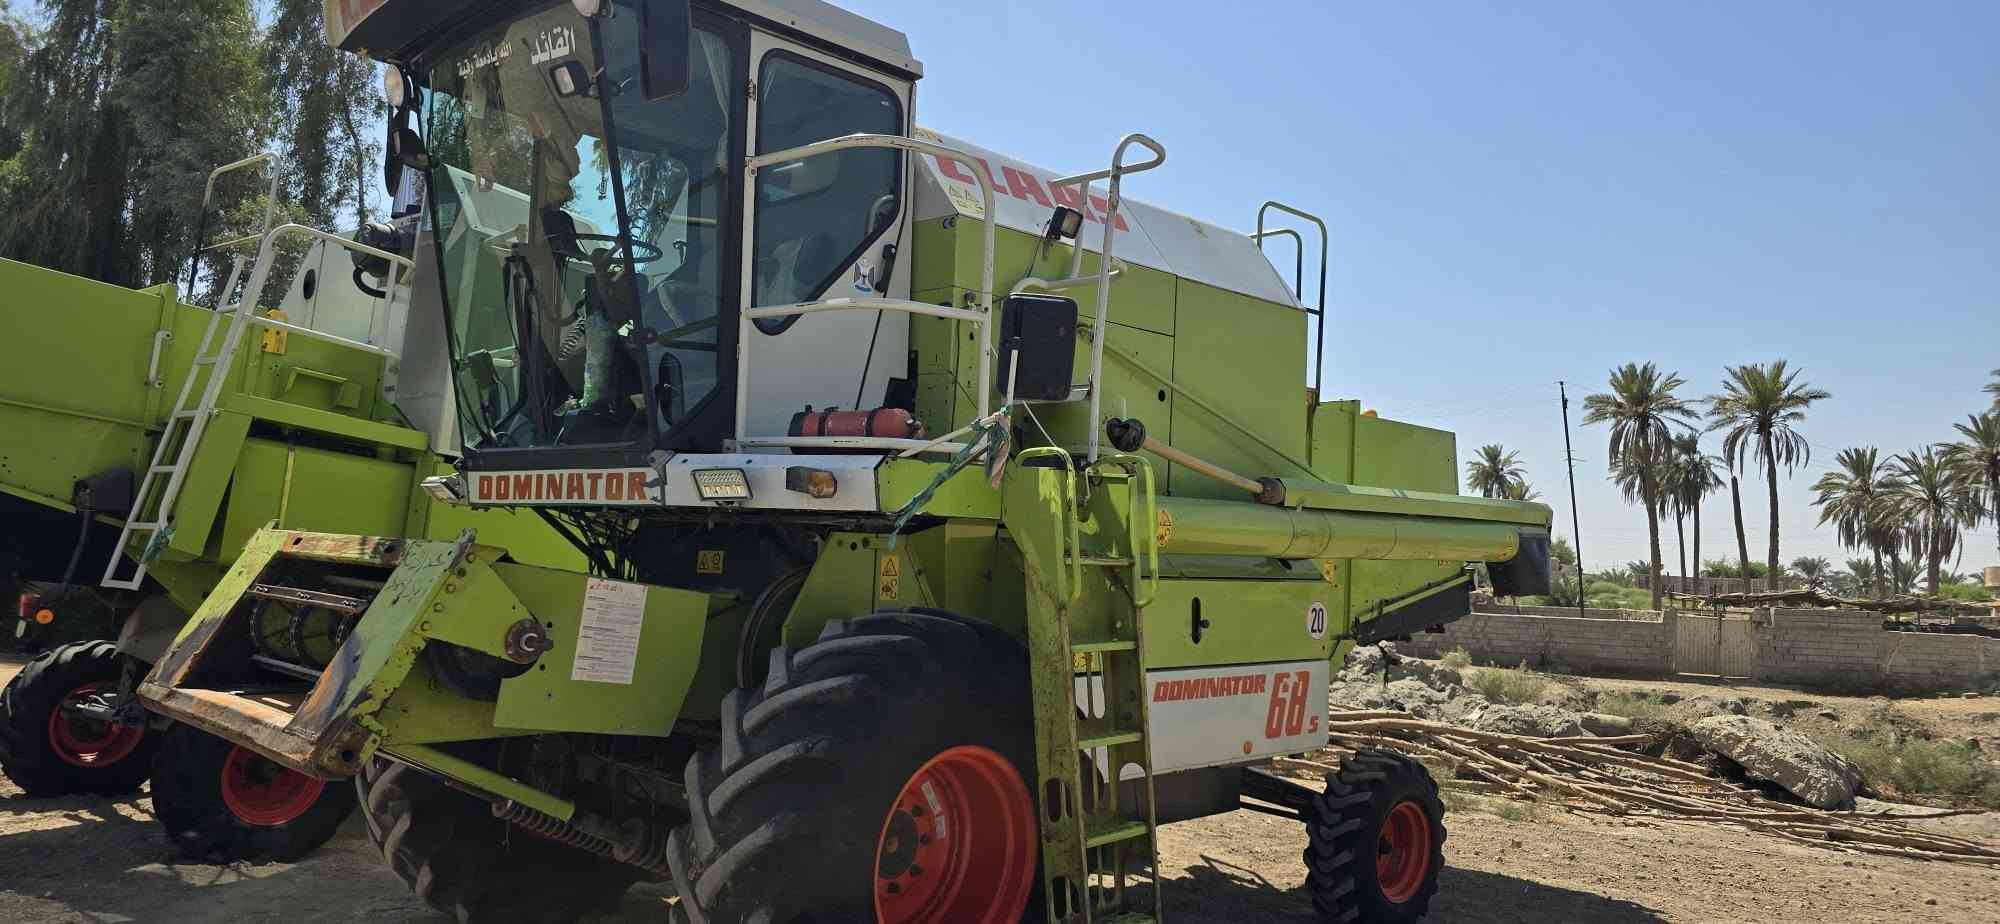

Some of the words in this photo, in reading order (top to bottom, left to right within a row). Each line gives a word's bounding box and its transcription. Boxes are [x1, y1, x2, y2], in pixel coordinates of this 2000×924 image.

[532, 24, 575, 64] القائد
[936, 155, 1129, 232] CLAAS
[478, 472, 648, 500] DOMINATOR
[1311, 607, 1324, 633] 20
[1153, 674, 1265, 702] DOMINATOR
[1265, 670, 1310, 739] 68
